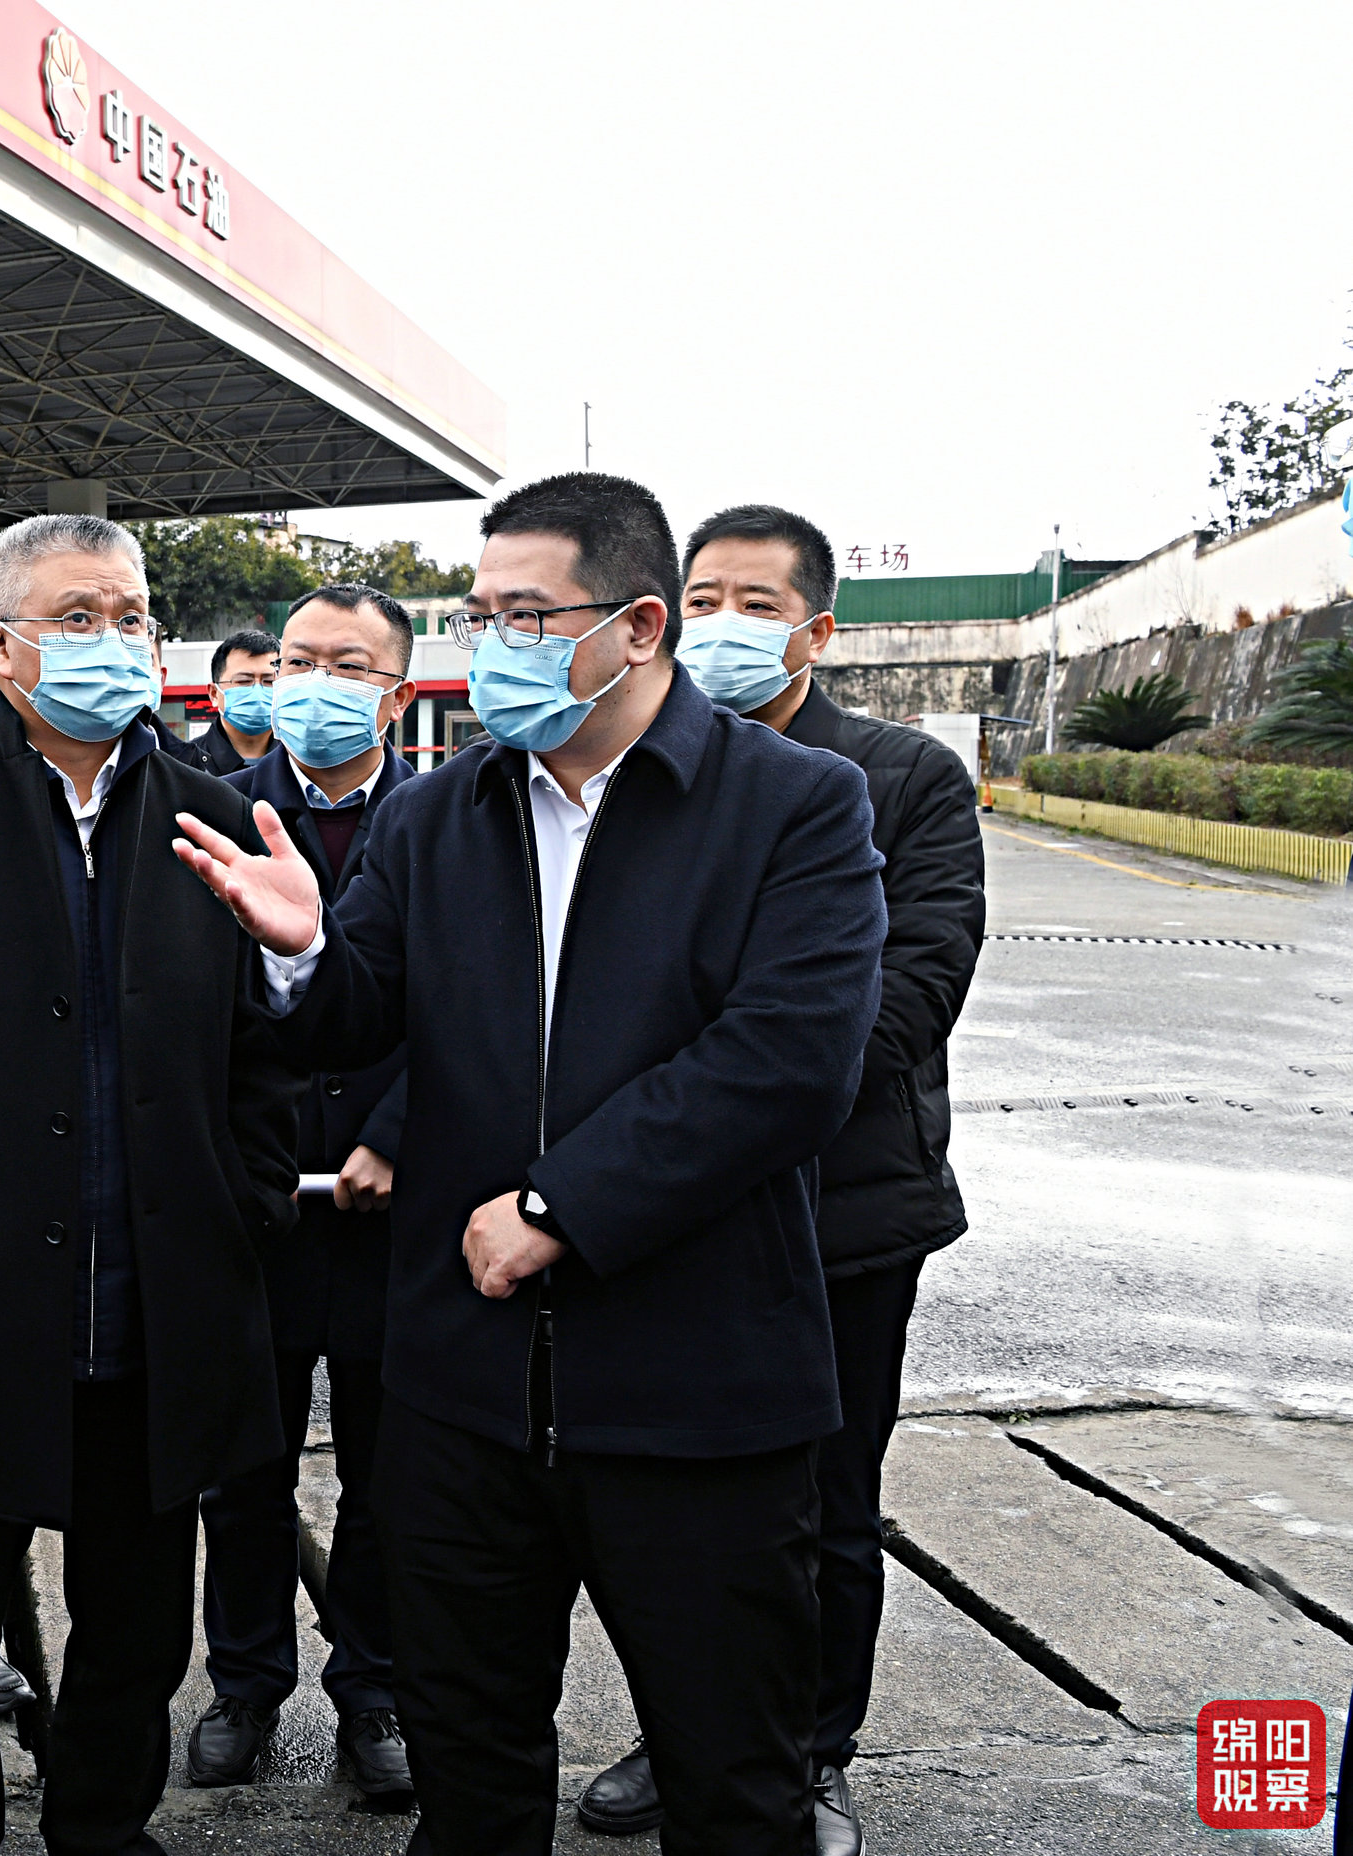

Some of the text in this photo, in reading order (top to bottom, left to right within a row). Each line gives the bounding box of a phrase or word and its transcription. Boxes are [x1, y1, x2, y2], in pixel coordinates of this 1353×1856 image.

[102, 90, 230, 240] 中国石油
[845, 544, 909, 573] 车场
